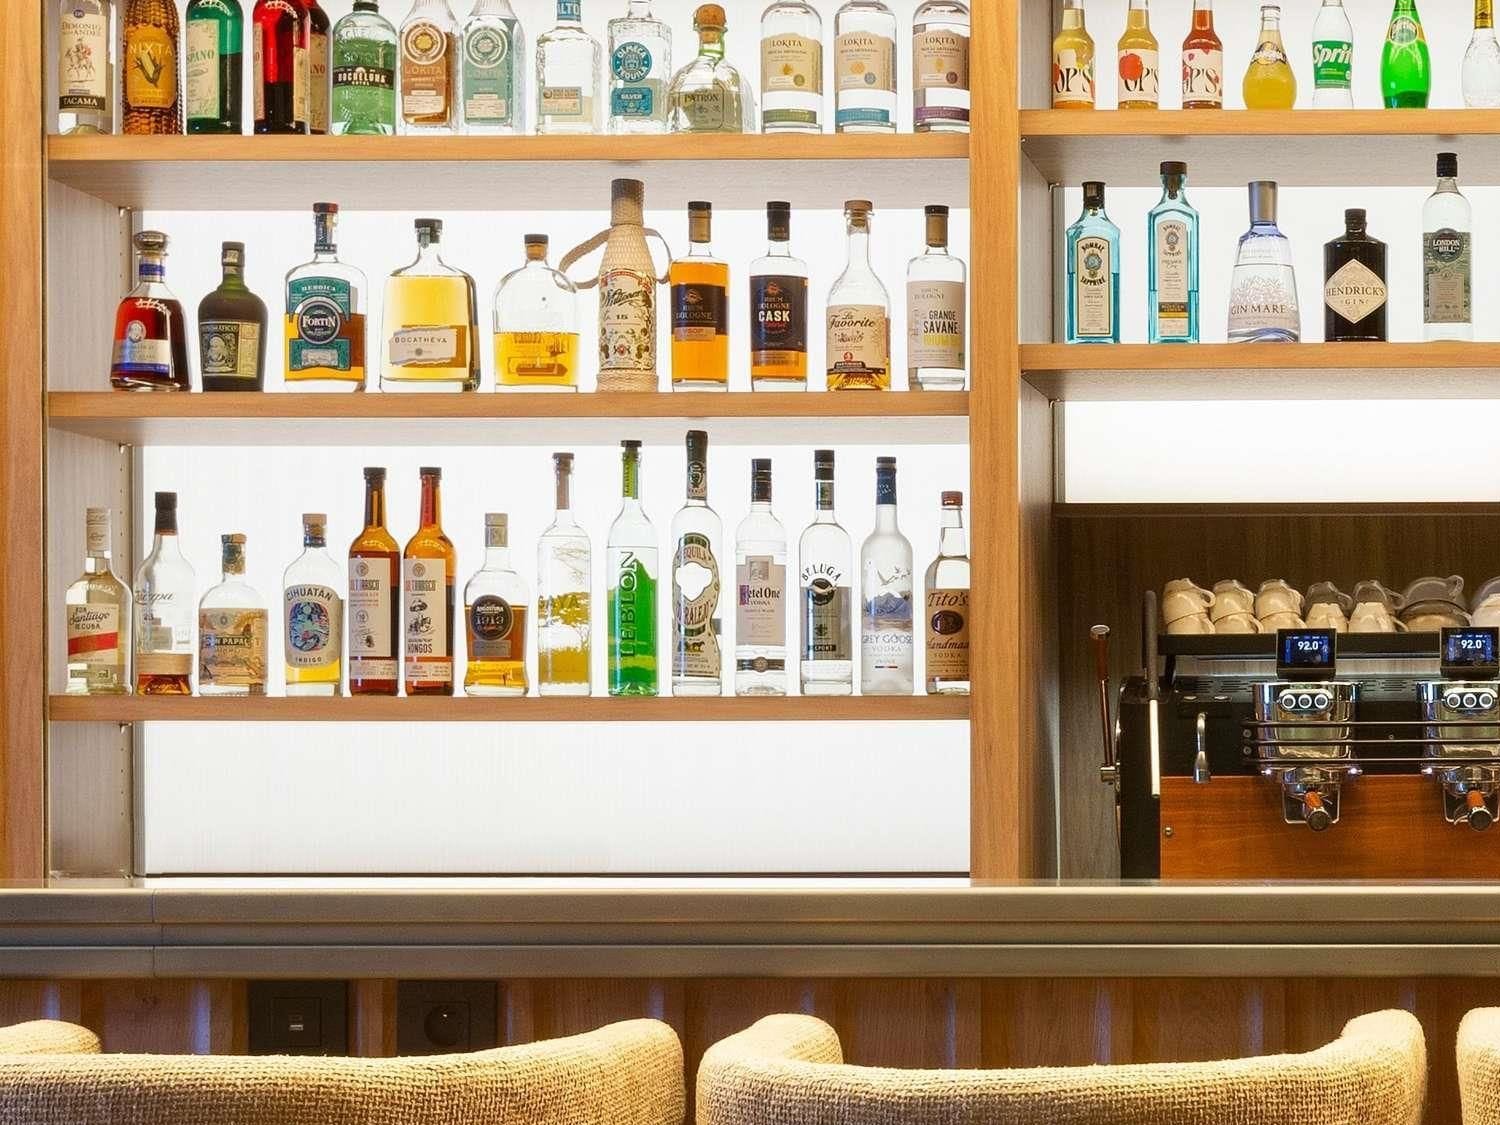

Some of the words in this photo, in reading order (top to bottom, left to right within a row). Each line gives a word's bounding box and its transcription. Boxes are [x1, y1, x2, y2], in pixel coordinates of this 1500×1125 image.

[772, 39, 802, 47] LOKITA
[844, 39, 874, 47] LOKITA
[129, 43, 173, 55] NIXTA
[63, 97, 98, 106] TACAMA
[1081, 242, 1105, 252] BOMBAY
[1433, 239, 1460, 247] LONDON
[1439, 245, 1455, 253] HILL
[1080, 277, 1107, 287] SAPPHIRE
[1325, 286, 1385, 297] HENDRICK'S
[1231, 303, 1247, 315] GIN
[1253, 304, 1286, 314] MARE
[758, 311, 790, 322] CASK
[830, 314, 875, 328] Favorite
[929, 310, 956, 321] GRANDE
[302, 315, 336, 328] FORTIN
[923, 321, 959, 334] SAVANE
[801, 563, 843, 582] BELUGA
[764, 587, 781, 599] One
[620, 551, 637, 657] LEBLON
[928, 592, 970, 607] Tito's
[70, 611, 111, 626] Santiago
[408, 643, 433, 654] HONGOS
